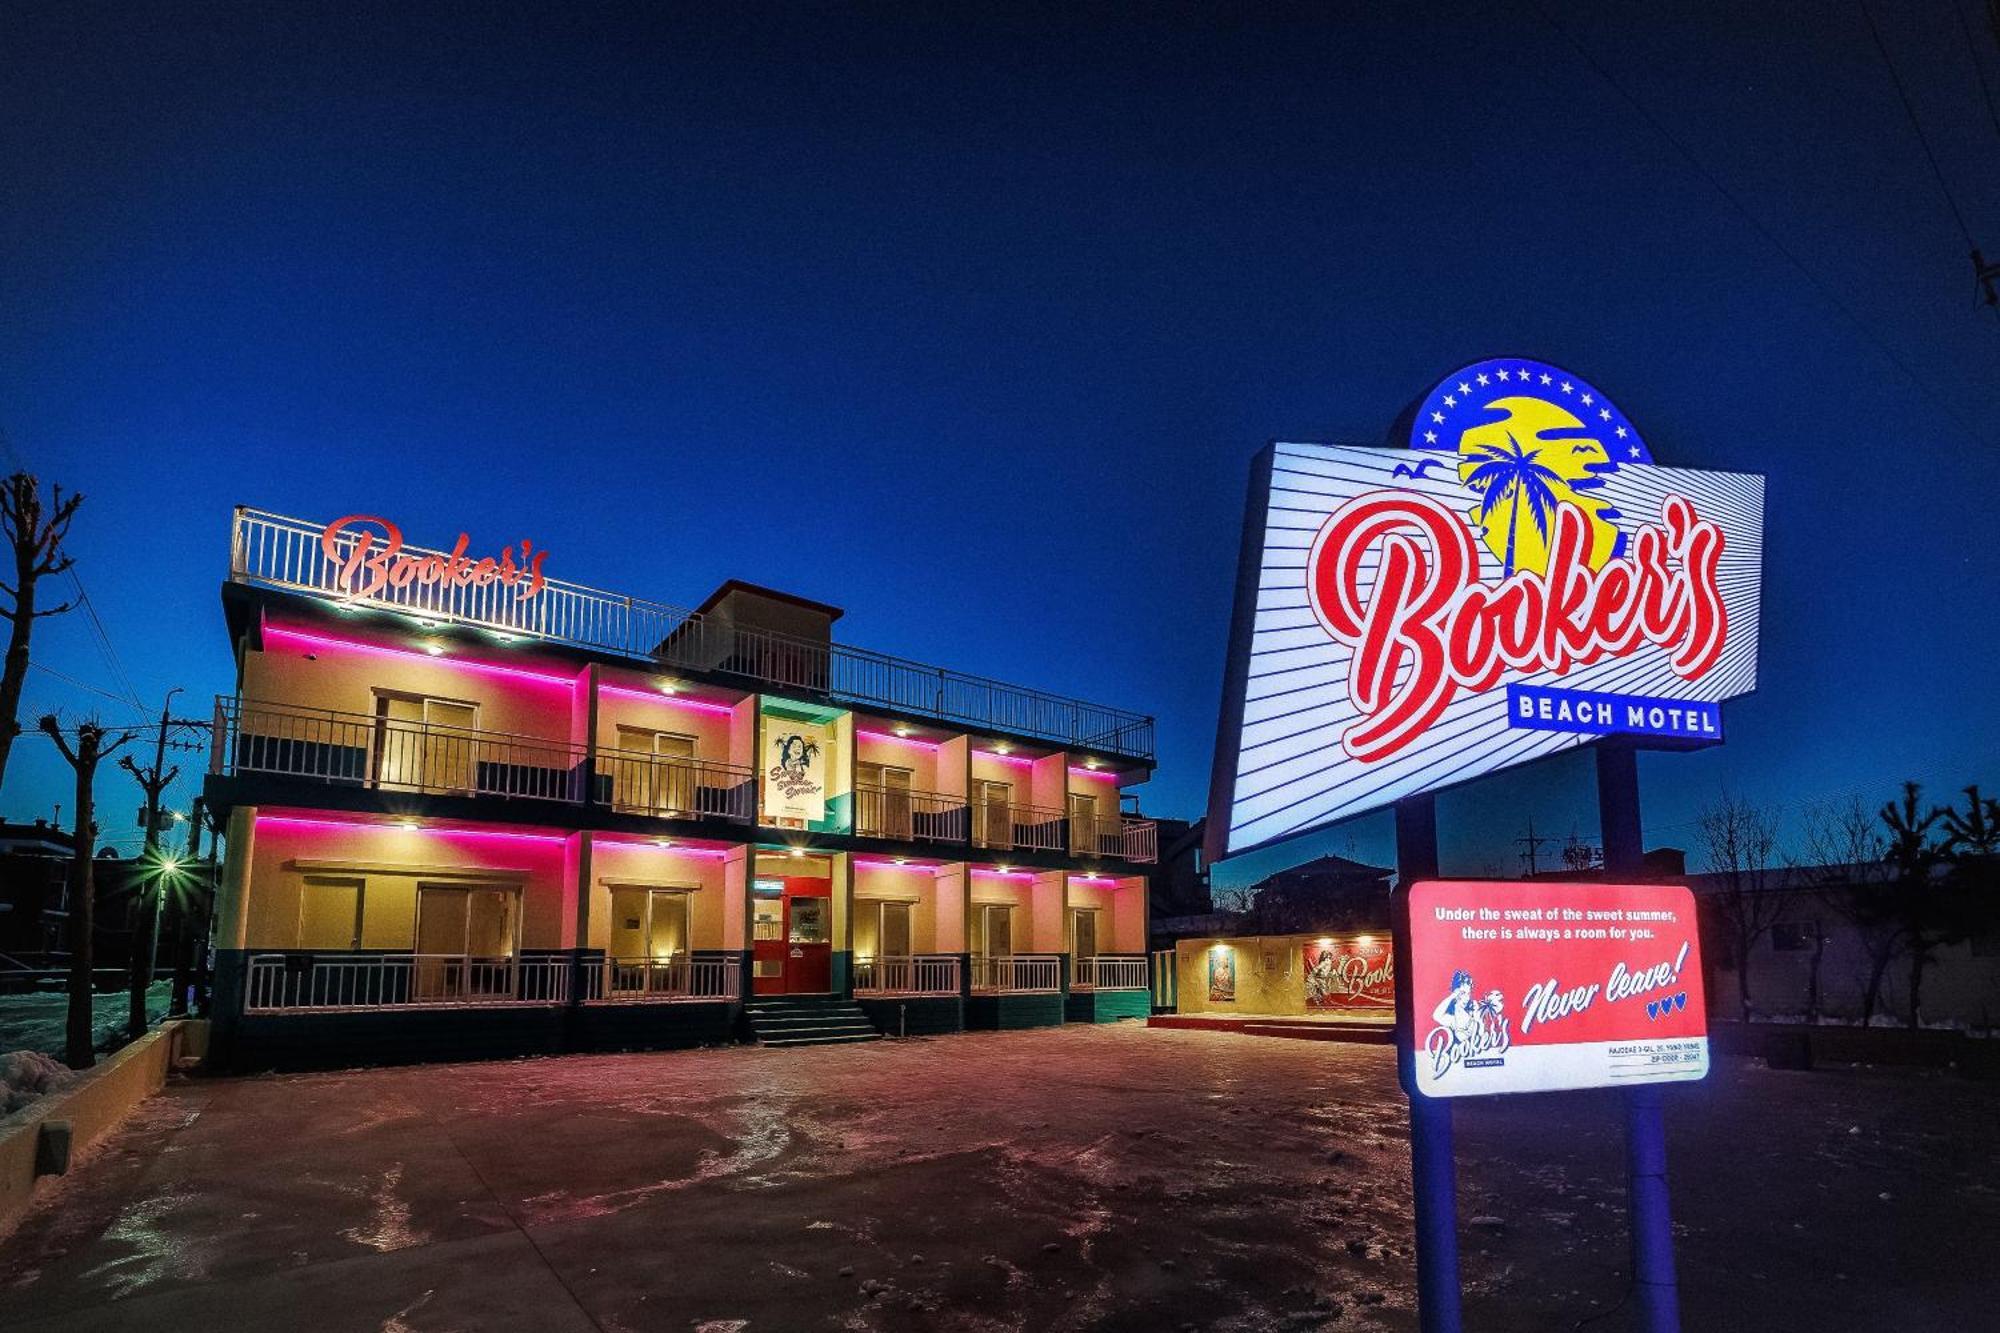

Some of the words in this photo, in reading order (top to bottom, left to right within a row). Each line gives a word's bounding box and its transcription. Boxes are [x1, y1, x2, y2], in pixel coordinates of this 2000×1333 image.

[322, 514, 549, 605] Booker's
[1307, 488, 1728, 763] Booker's
[1519, 696, 1613, 725] BEACH
[1627, 706, 1715, 732] MOTEL
[1435, 907, 1476, 921] Under
[1479, 907, 1501, 921] the
[1504, 908, 1543, 921] sweat
[1546, 907, 1559, 921] of
[1562, 908, 1583, 921] the
[1586, 909, 1623, 921] sweet
[1625, 910, 1677, 923] summer,
[1462, 926, 1497, 939] there
[1500, 927, 1512, 939] is
[1516, 926, 1560, 942] always
[1563, 929, 1572, 939] a
[1575, 928, 1607, 938] room
[1609, 926, 1626, 938] for
[1629, 928, 1655, 941] you.
[1521, 978, 1600, 1034] Never
[1605, 940, 1690, 1002] leave!
[1425, 1014, 1511, 1080] Booker's
